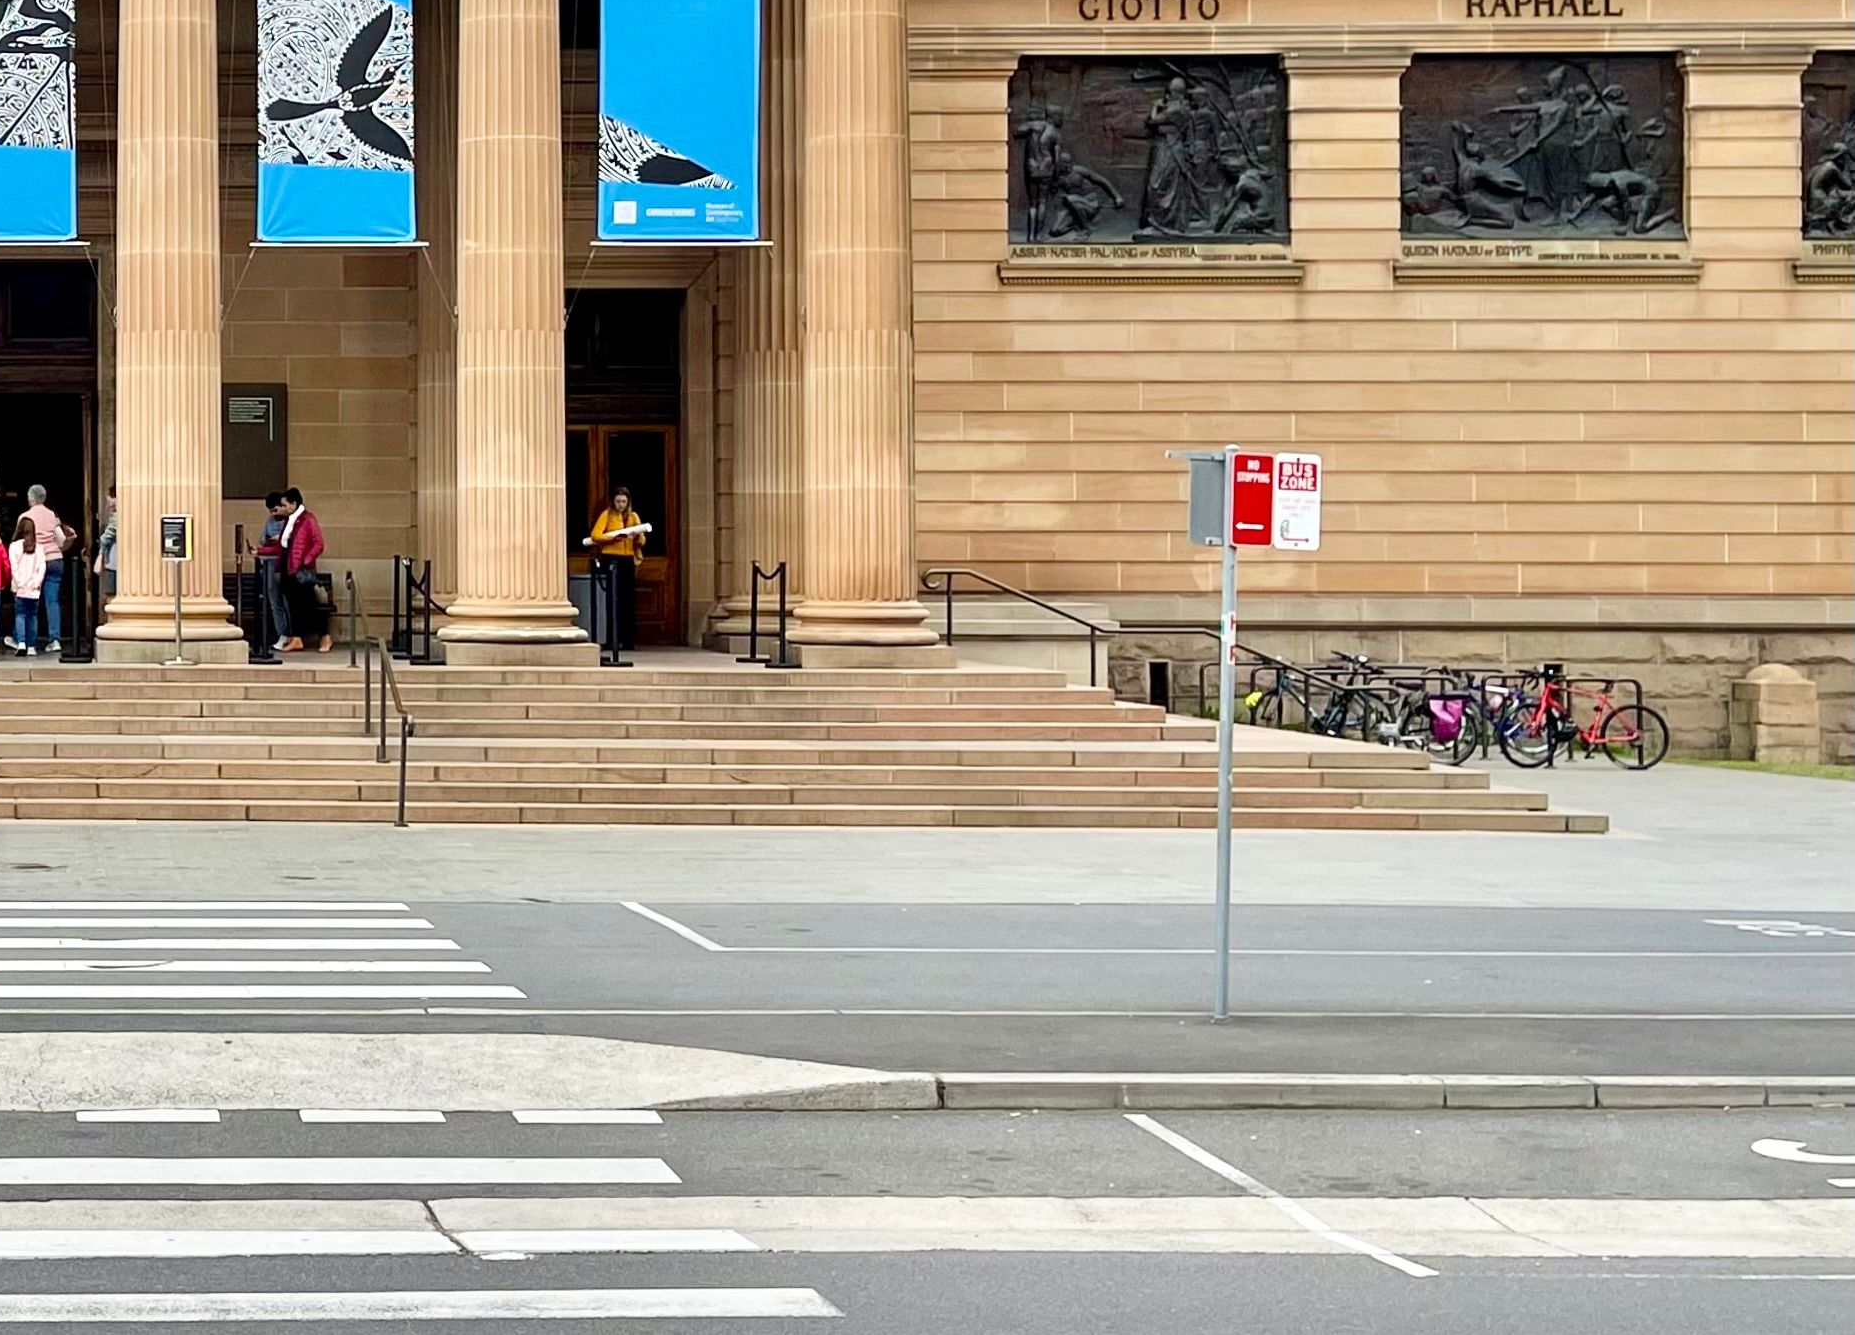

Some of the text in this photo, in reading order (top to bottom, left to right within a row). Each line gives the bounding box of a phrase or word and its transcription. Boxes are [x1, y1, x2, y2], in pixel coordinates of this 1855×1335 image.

[1247, 459, 1261, 472] NO
[1282, 463, 1314, 479] BUS
[1236, 471, 1271, 484] STOPPING
[1280, 475, 1316, 491] ZONE
